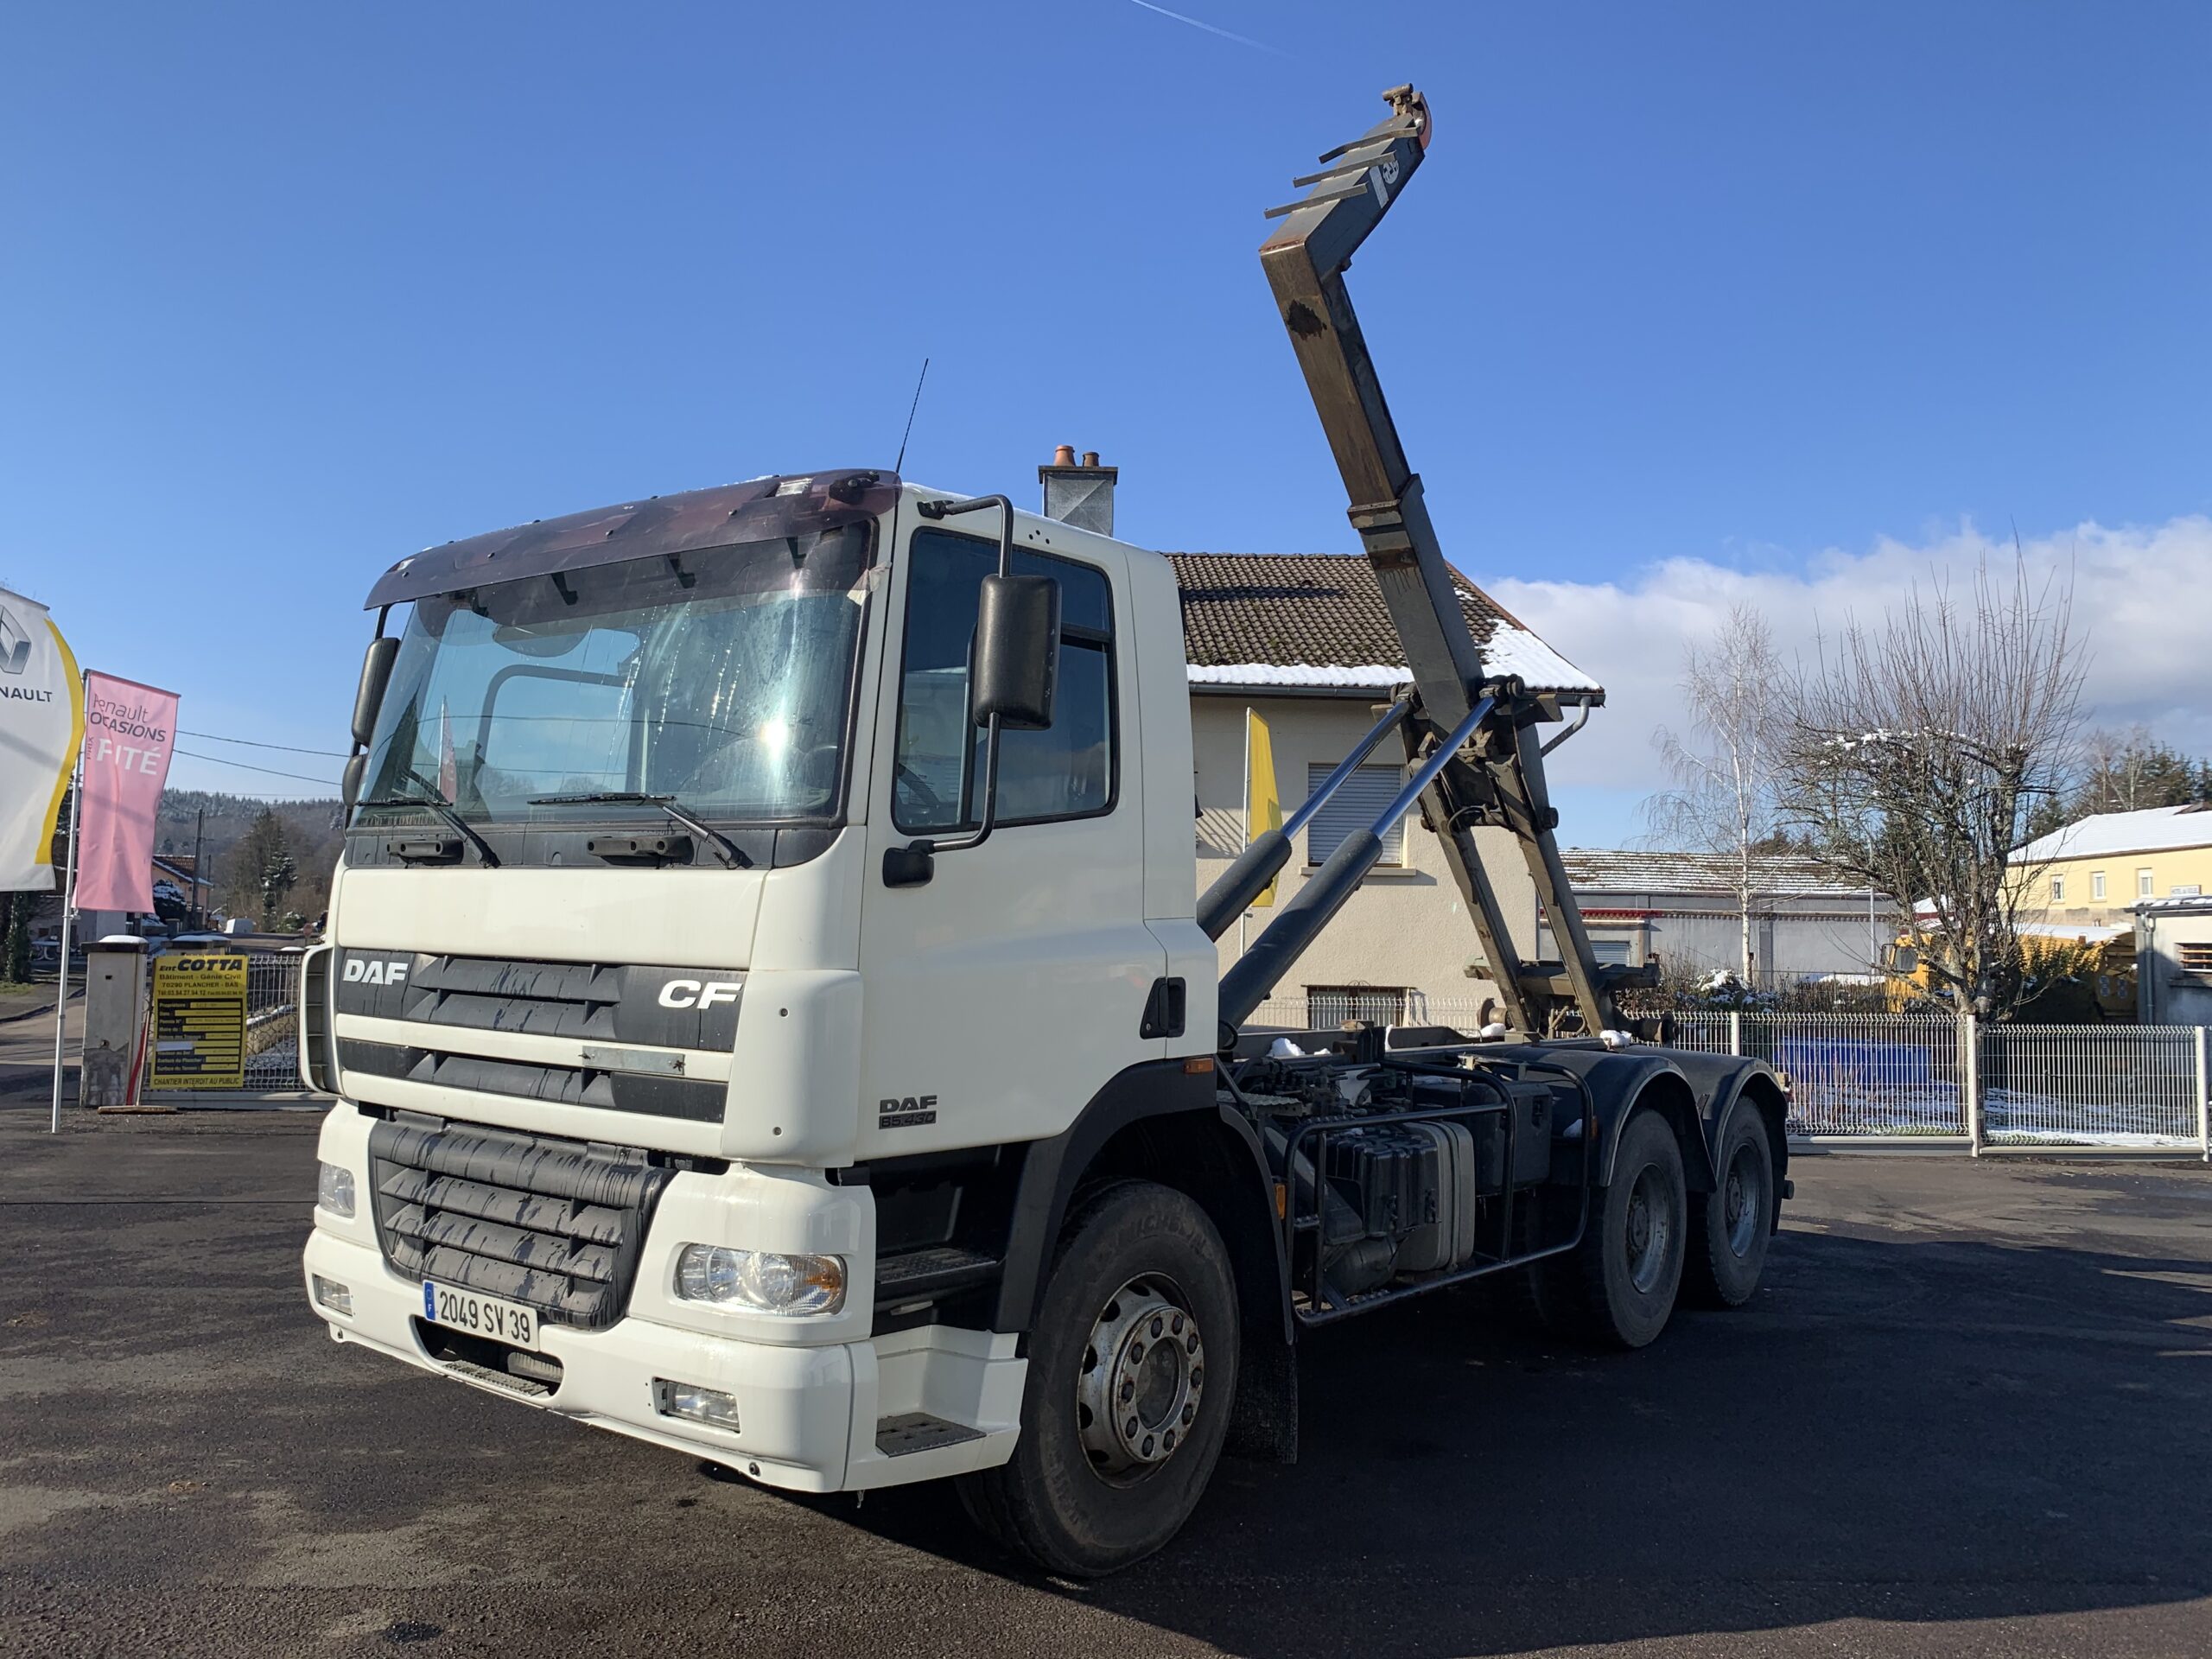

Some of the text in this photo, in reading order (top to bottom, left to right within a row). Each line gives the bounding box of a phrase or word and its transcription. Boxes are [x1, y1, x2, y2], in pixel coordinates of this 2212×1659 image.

[177, 959, 243, 971] COTTA
[343, 959, 409, 985] DAF
[658, 980, 743, 1009] CF
[880, 1095, 938, 1113] DAF
[440, 1291, 531, 1343] 2049 SV 39
